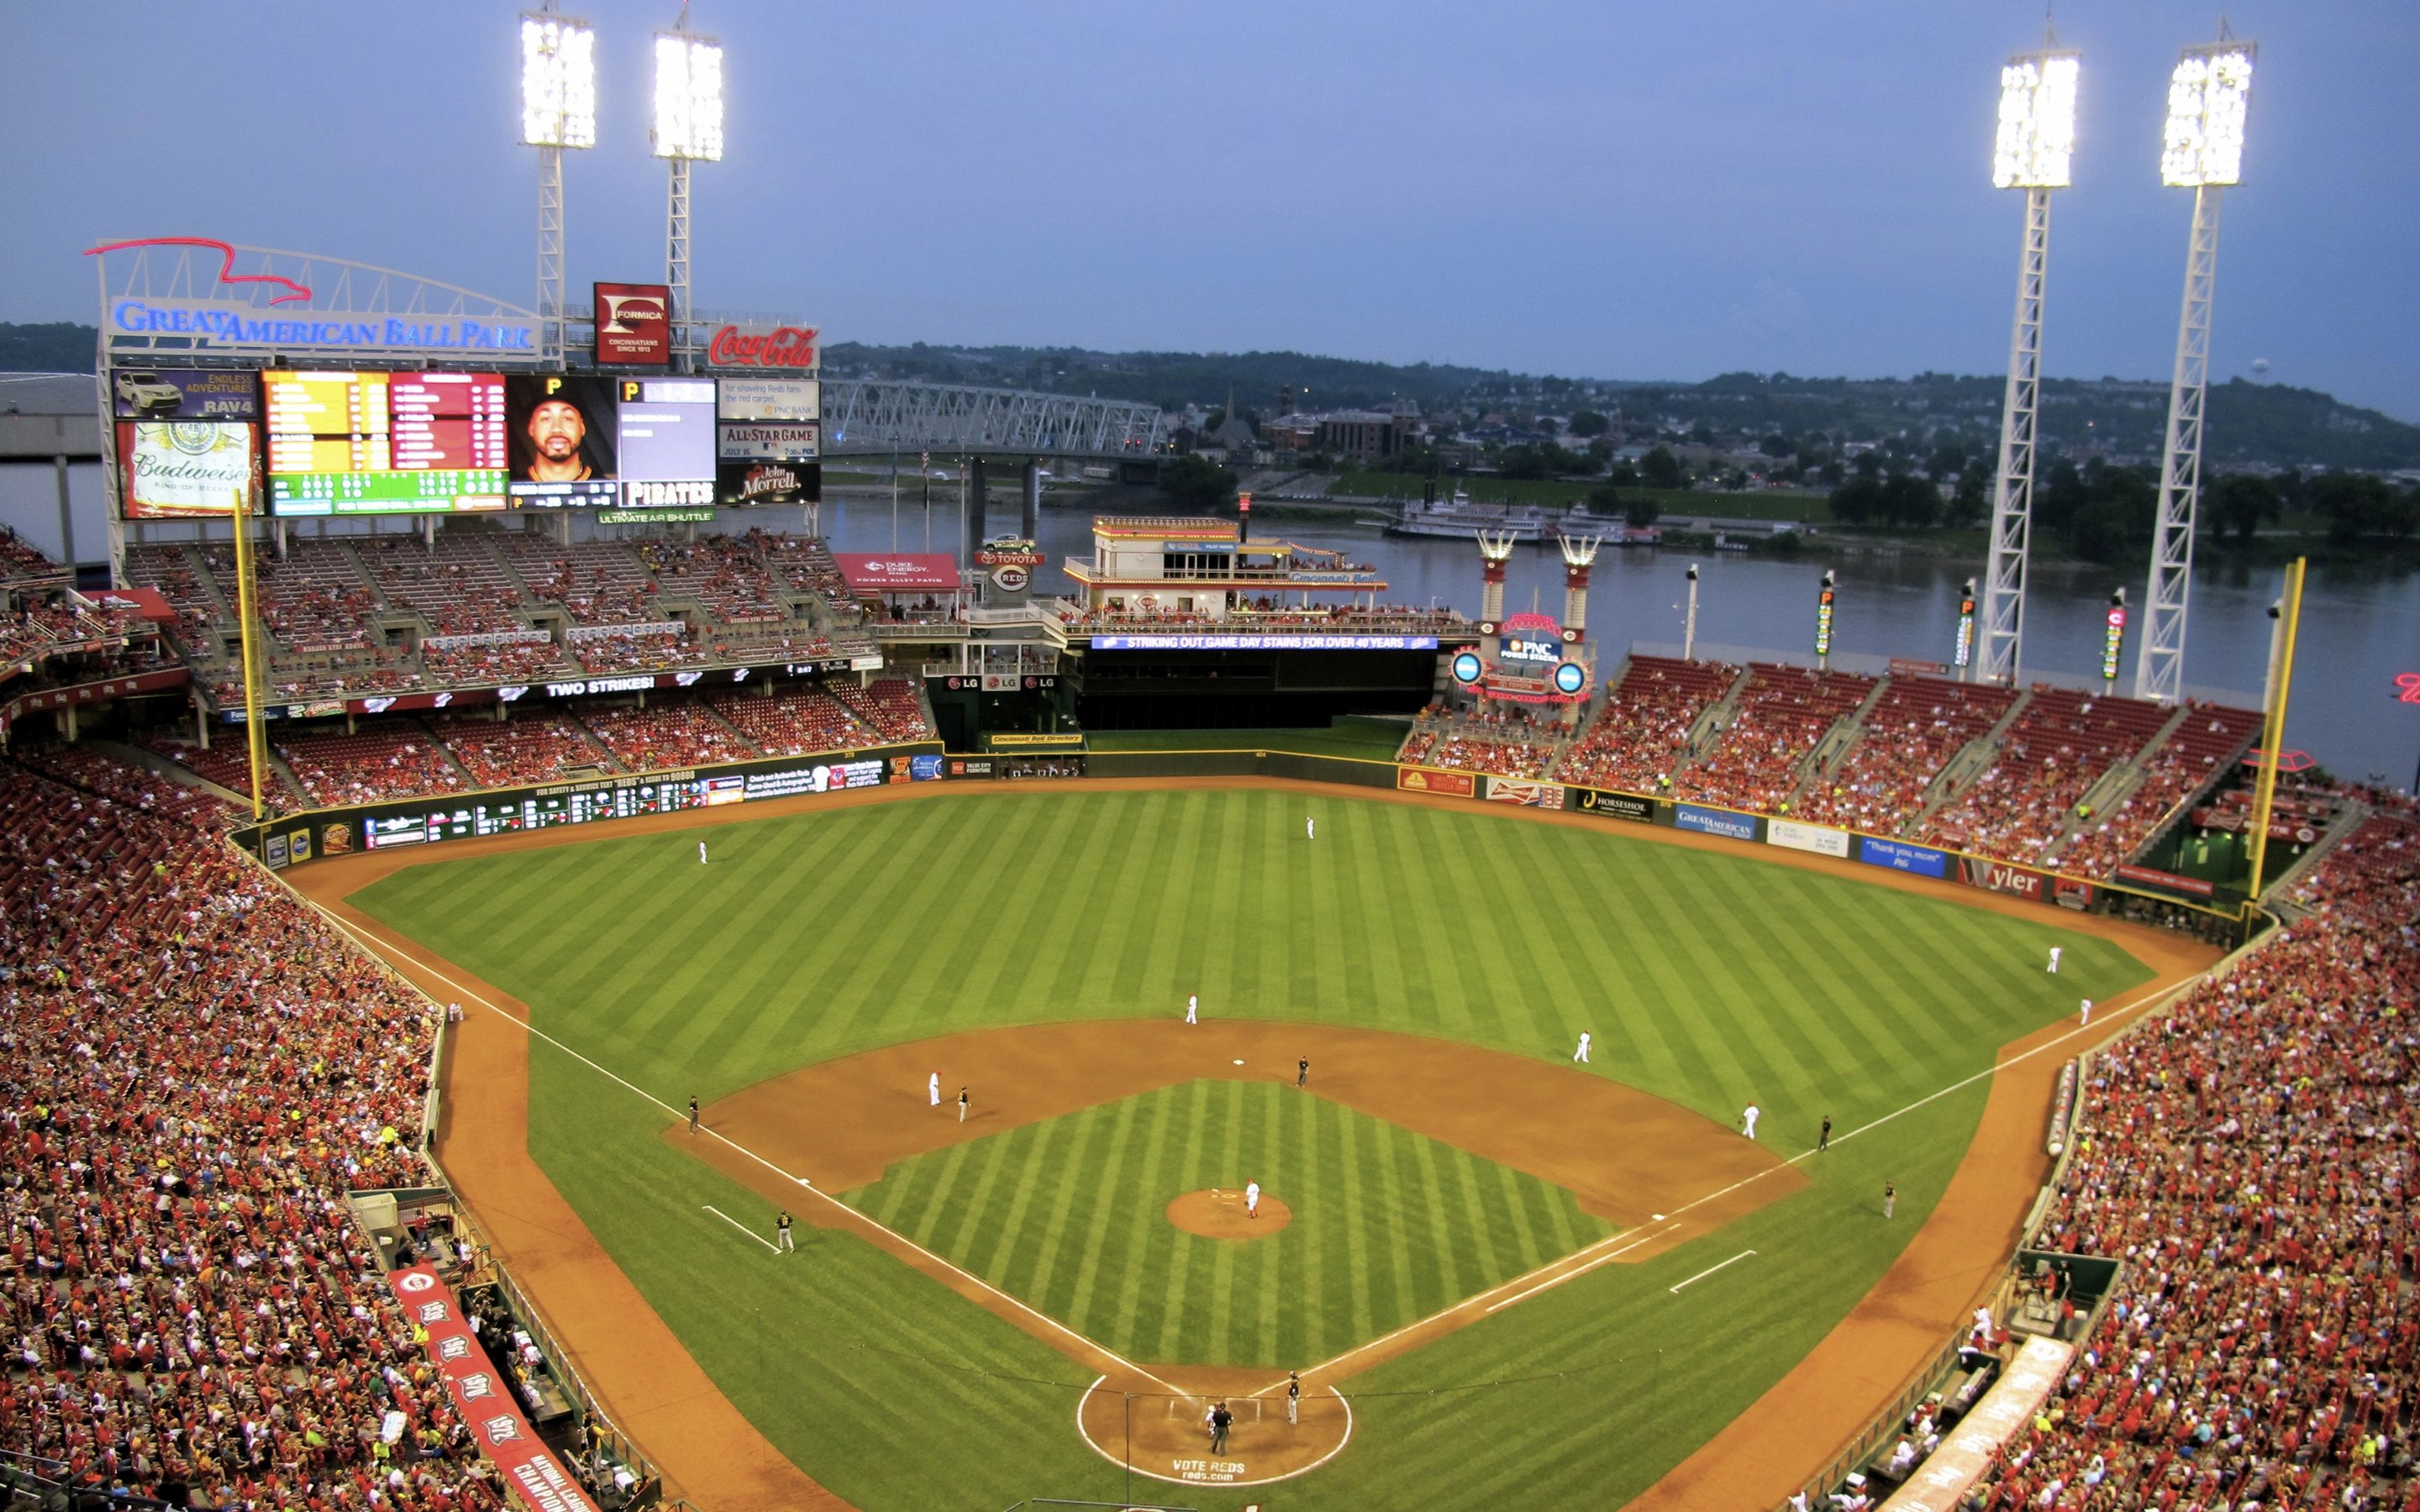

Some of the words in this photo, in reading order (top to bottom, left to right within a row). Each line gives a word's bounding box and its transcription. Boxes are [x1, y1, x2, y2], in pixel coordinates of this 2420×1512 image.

[617, 311, 662, 319] FORMICA
[114, 301, 229, 333] GREAT
[217, 312, 377, 344] AMERICAN
[383, 318, 456, 348] BALL
[459, 319, 533, 349] PARK
[608, 339, 659, 347] CINCINNATIANS
[709, 324, 819, 368] Coca-Cola
[208, 375, 252, 384] ENDLESS
[186, 384, 253, 393] ADVENTURES
[738, 385, 766, 393] showing
[786, 387, 802, 396] fans
[203, 401, 255, 413] RAV4
[781, 429, 813, 441] GAME
[762, 465, 786, 479] John
[738, 472, 802, 501] Morrell
[627, 482, 714, 506] PIRATES
[600, 513, 648, 523] ULTIMATE
[667, 512, 711, 522] SHUTTLE
[997, 555, 1038, 564] TOYOTA
[1128, 637, 1178, 648] STRIKING
[1180, 637, 1204, 648] OUT
[1206, 637, 1238, 648] GAME
[1239, 637, 1261, 648] DAY
[1263, 637, 1302, 648] STAINS
[1303, 637, 1324, 648] FOR
[1328, 637, 1355, 648] OVER
[1356, 637, 1369, 648] 40
[1370, 637, 1404, 648] YEARS
[1522, 642, 1552, 654] PNC
[1500, 650, 1528, 659] POWER
[547, 683, 586, 697] TWO
[588, 676, 655, 694] STRIKES!
[963, 679, 978, 688] LG
[1002, 679, 1016, 687] LG
[1039, 679, 1054, 687] LG
[549, 786, 570, 795] SAFETY
[576, 784, 600, 792] SERVICE
[1597, 798, 1646, 811] HORSESHOE
[1678, 811, 1712, 824] GREAT
[1707, 817, 1752, 834] AMERICAN
[1865, 840, 1895, 854] "Thank
[441, 1336, 466, 1357] 1961
[464, 1373, 488, 1396] 1970
[488, 1415, 515, 1441] 1972
[1173, 1459, 1207, 1471] VOTE
[1209, 1462, 1245, 1473] REDS
[1182, 1471, 1234, 1481] reds.com
[530, 1454, 567, 1490] NATIONAL
[558, 1488, 592, 1512] LEAGU
